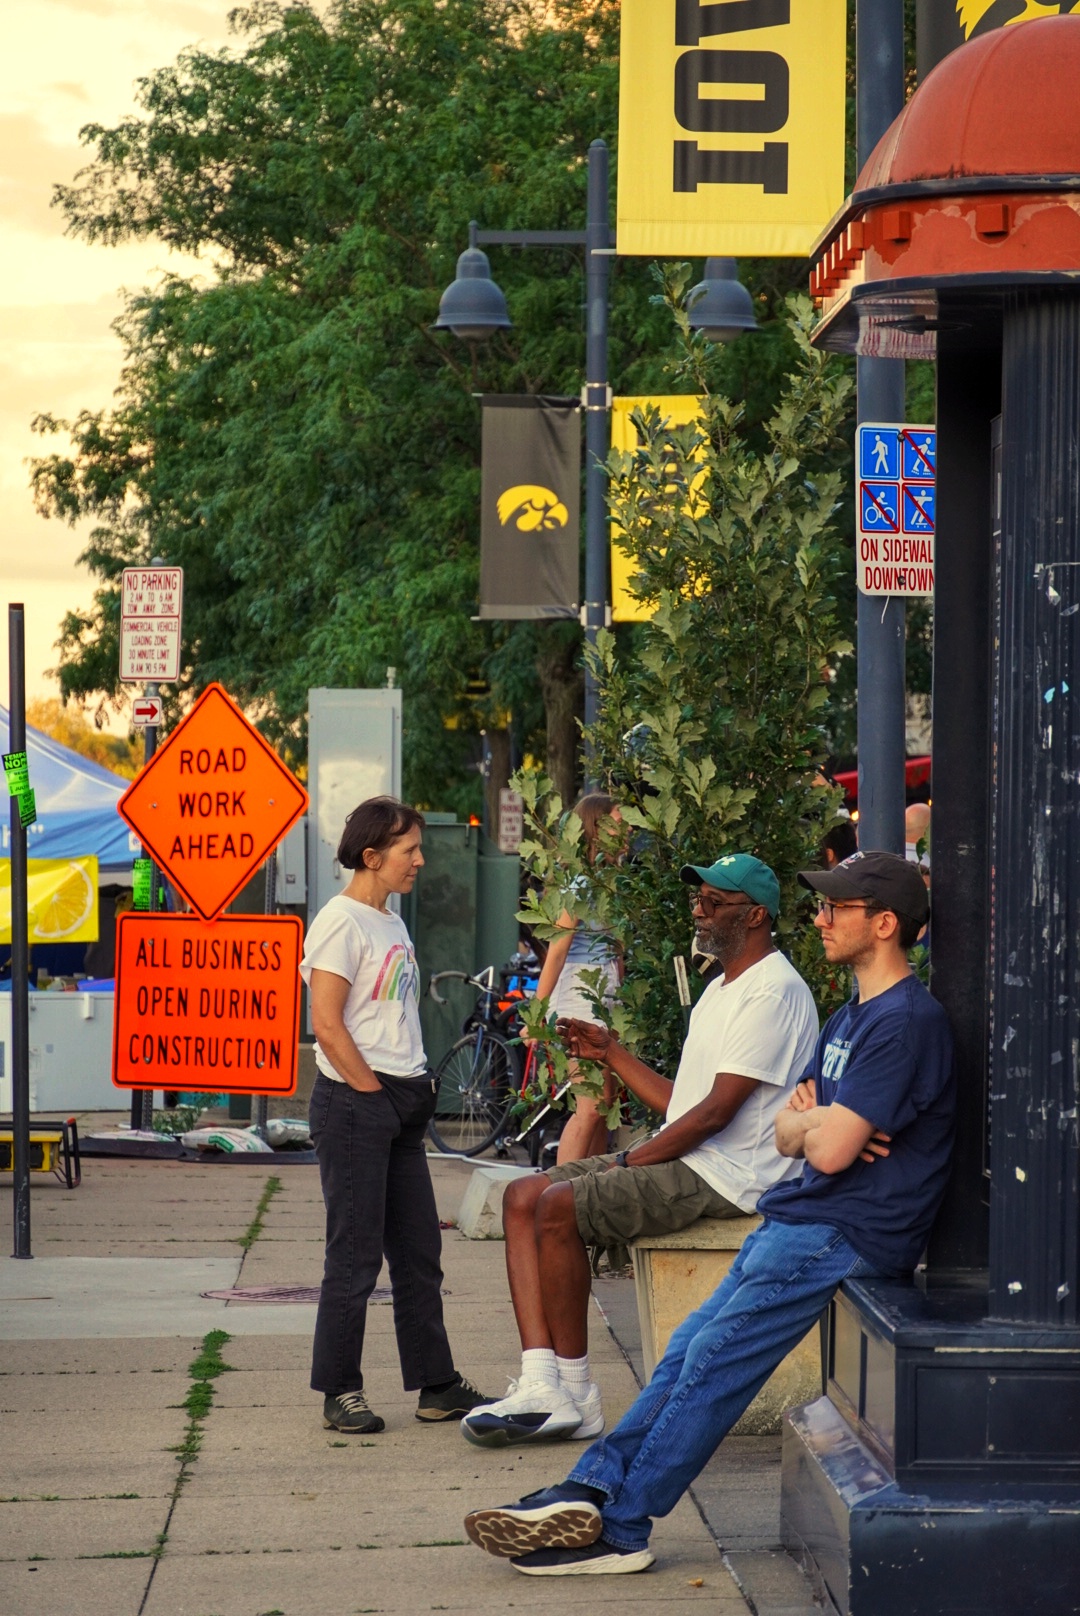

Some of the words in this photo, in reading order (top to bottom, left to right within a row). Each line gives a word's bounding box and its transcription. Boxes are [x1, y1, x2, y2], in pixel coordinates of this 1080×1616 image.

[861, 538, 878, 562] ON
[126, 574, 138, 591] NO
[141, 573, 177, 591] PARKING
[865, 566, 935, 592] DOWNTOWN
[130, 592, 134, 603] 2
[136, 592, 143, 602] AM
[148, 592, 155, 602] TO
[165, 592, 173, 602] AM
[127, 603, 138, 614] TOW
[142, 603, 156, 614] AWAY
[161, 603, 175, 614] ZONE
[124, 621, 154, 632] COMMERCIAL
[157, 621, 177, 632] VEHICLE
[131, 635, 152, 646] LOADING
[154, 635, 167, 646] ZONE
[128, 649, 136, 660] 30
[138, 649, 155, 660] MINUTE
[157, 649, 170, 660] LIMIT
[136, 663, 143, 673] AM
[145, 662, 152, 673] TO
[159, 662, 167, 673] PM
[5, 759, 21, 769] NO
[180, 747, 247, 775] ROAD
[178, 790, 246, 818] WORK
[169, 833, 254, 860] AHEAD
[135, 938, 172, 968] ALL
[182, 939, 282, 971] BUSINESS
[137, 985, 189, 1017] OPEN
[199, 988, 277, 1021] DURING
[129, 1033, 281, 1070] CONSTRUCTION
